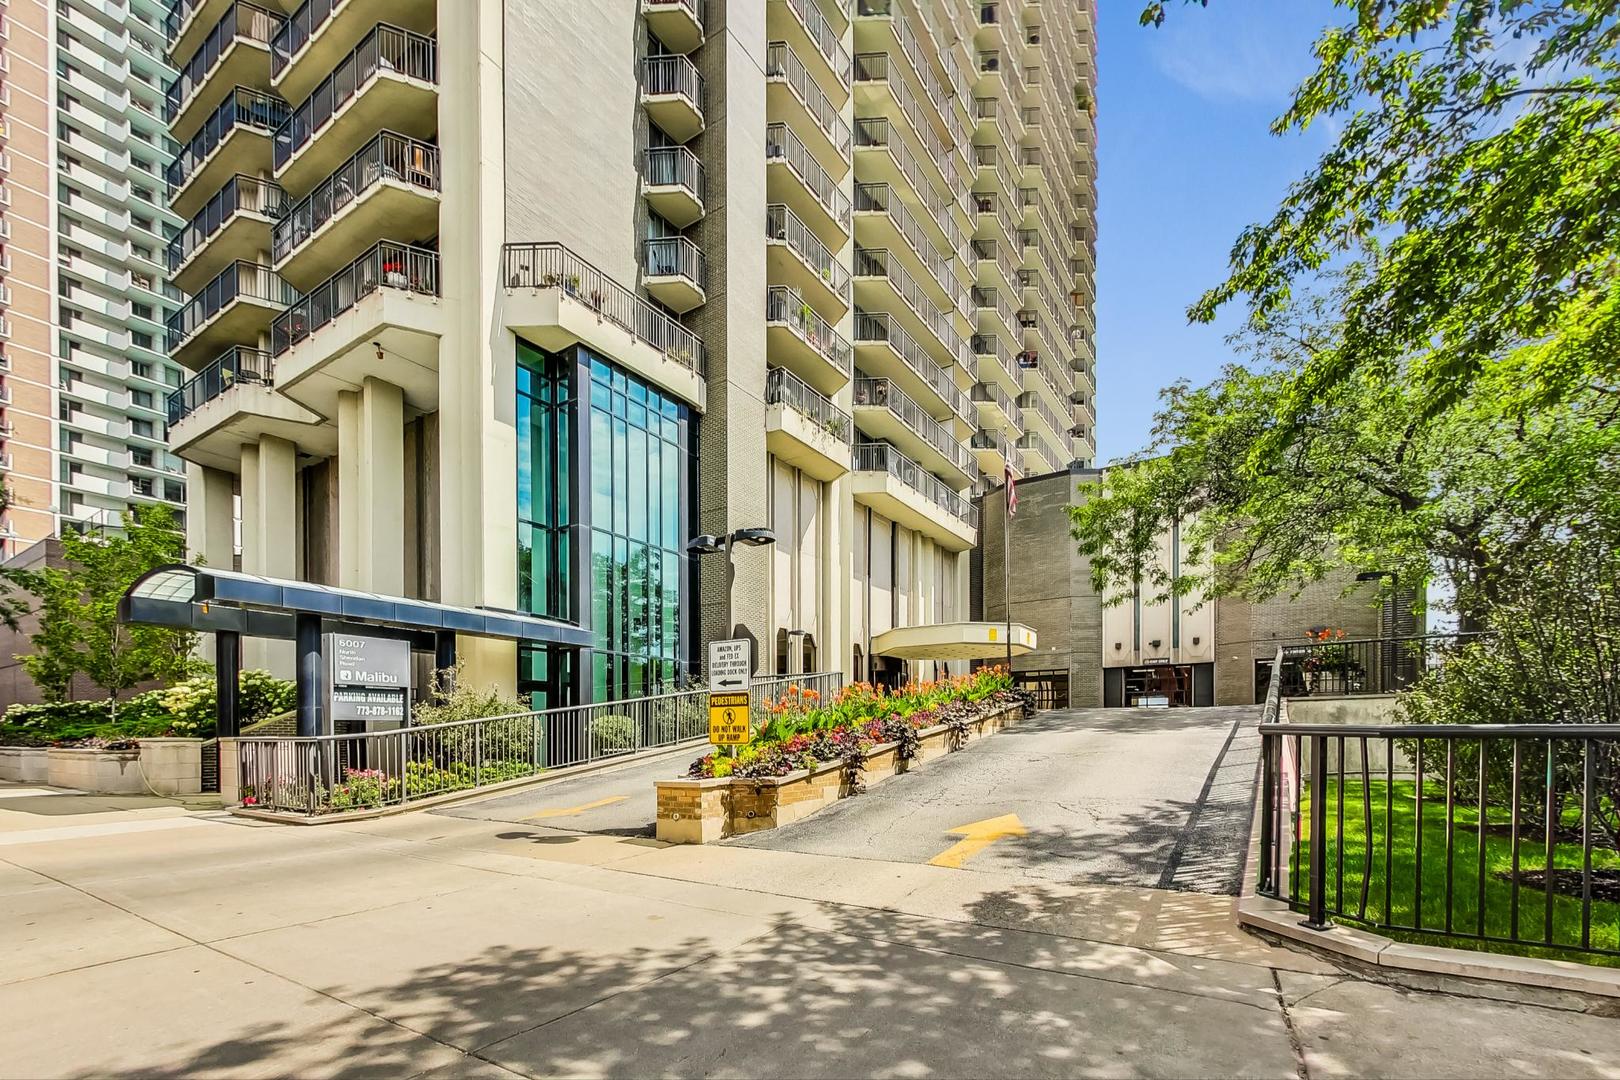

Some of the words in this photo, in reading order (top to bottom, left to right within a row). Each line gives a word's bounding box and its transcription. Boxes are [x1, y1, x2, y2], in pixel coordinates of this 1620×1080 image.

[339, 640, 366, 648] 6007
[356, 671, 398, 682] Malibu
[334, 692, 366, 702] PARKING
[367, 694, 404, 704] AVAILABLE
[711, 696, 748, 706] PEDESTRIANS
